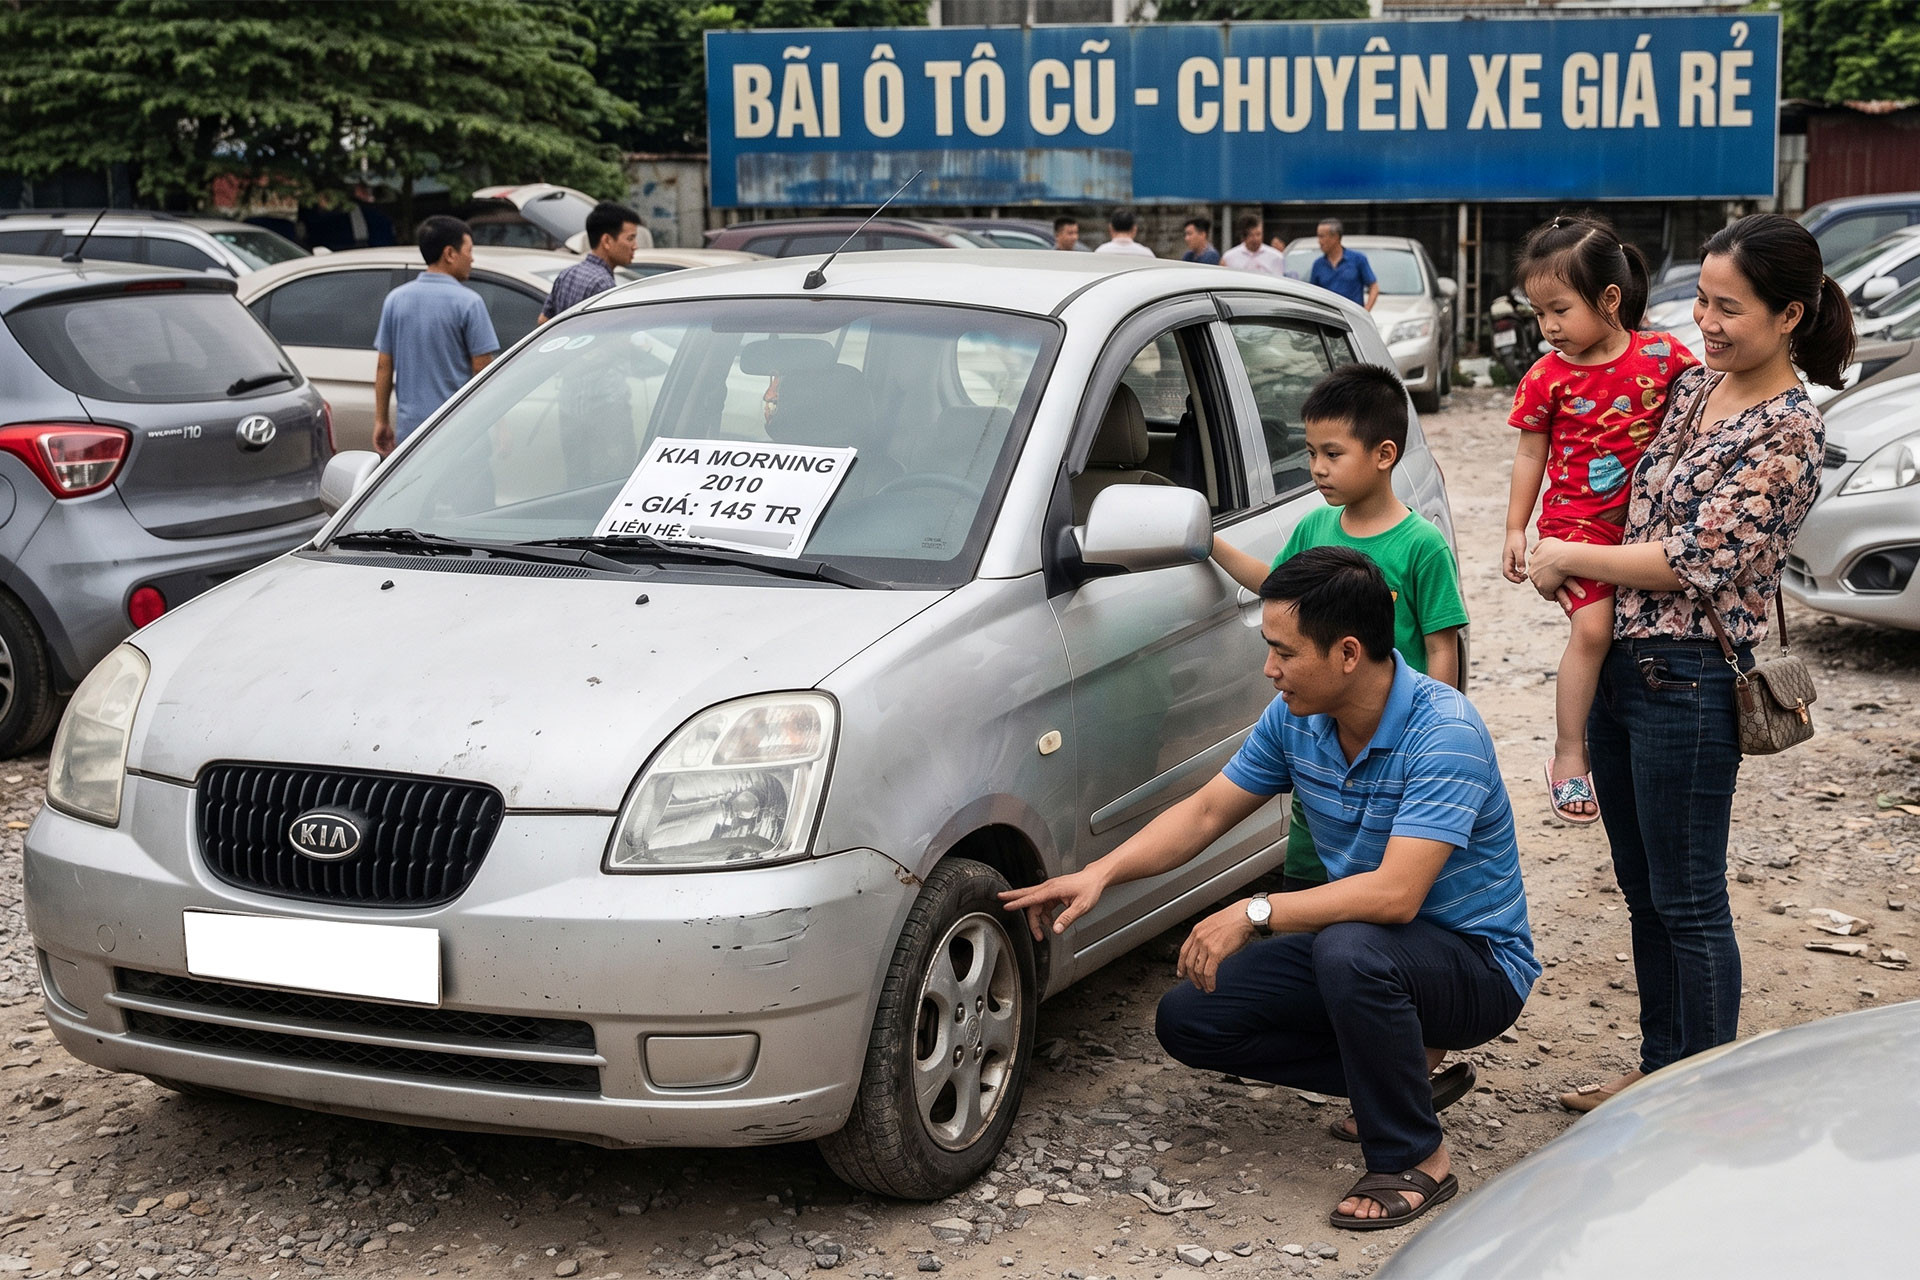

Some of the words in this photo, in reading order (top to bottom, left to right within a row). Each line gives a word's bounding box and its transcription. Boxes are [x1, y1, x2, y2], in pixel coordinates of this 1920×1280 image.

[733, 46, 840, 138] BÃI
[864, 43, 905, 138] Ô
[925, 41, 1006, 137] TÔ
[1029, 39, 1116, 136] CŨ
[1177, 37, 1448, 135] CHUYÊN
[1467, 54, 1542, 130] XE
[1562, 34, 1660, 130] GIÁ
[1679, 21, 1754, 128] RẺ
[656, 447, 699, 465] KIA
[706, 450, 836, 473] MORNING
[700, 474, 763, 493] 2010
[641, 493, 699, 516] GIÁ:
[709, 500, 756, 520] 145
[764, 504, 802, 525] TR
[300, 823, 347, 849] KIA
